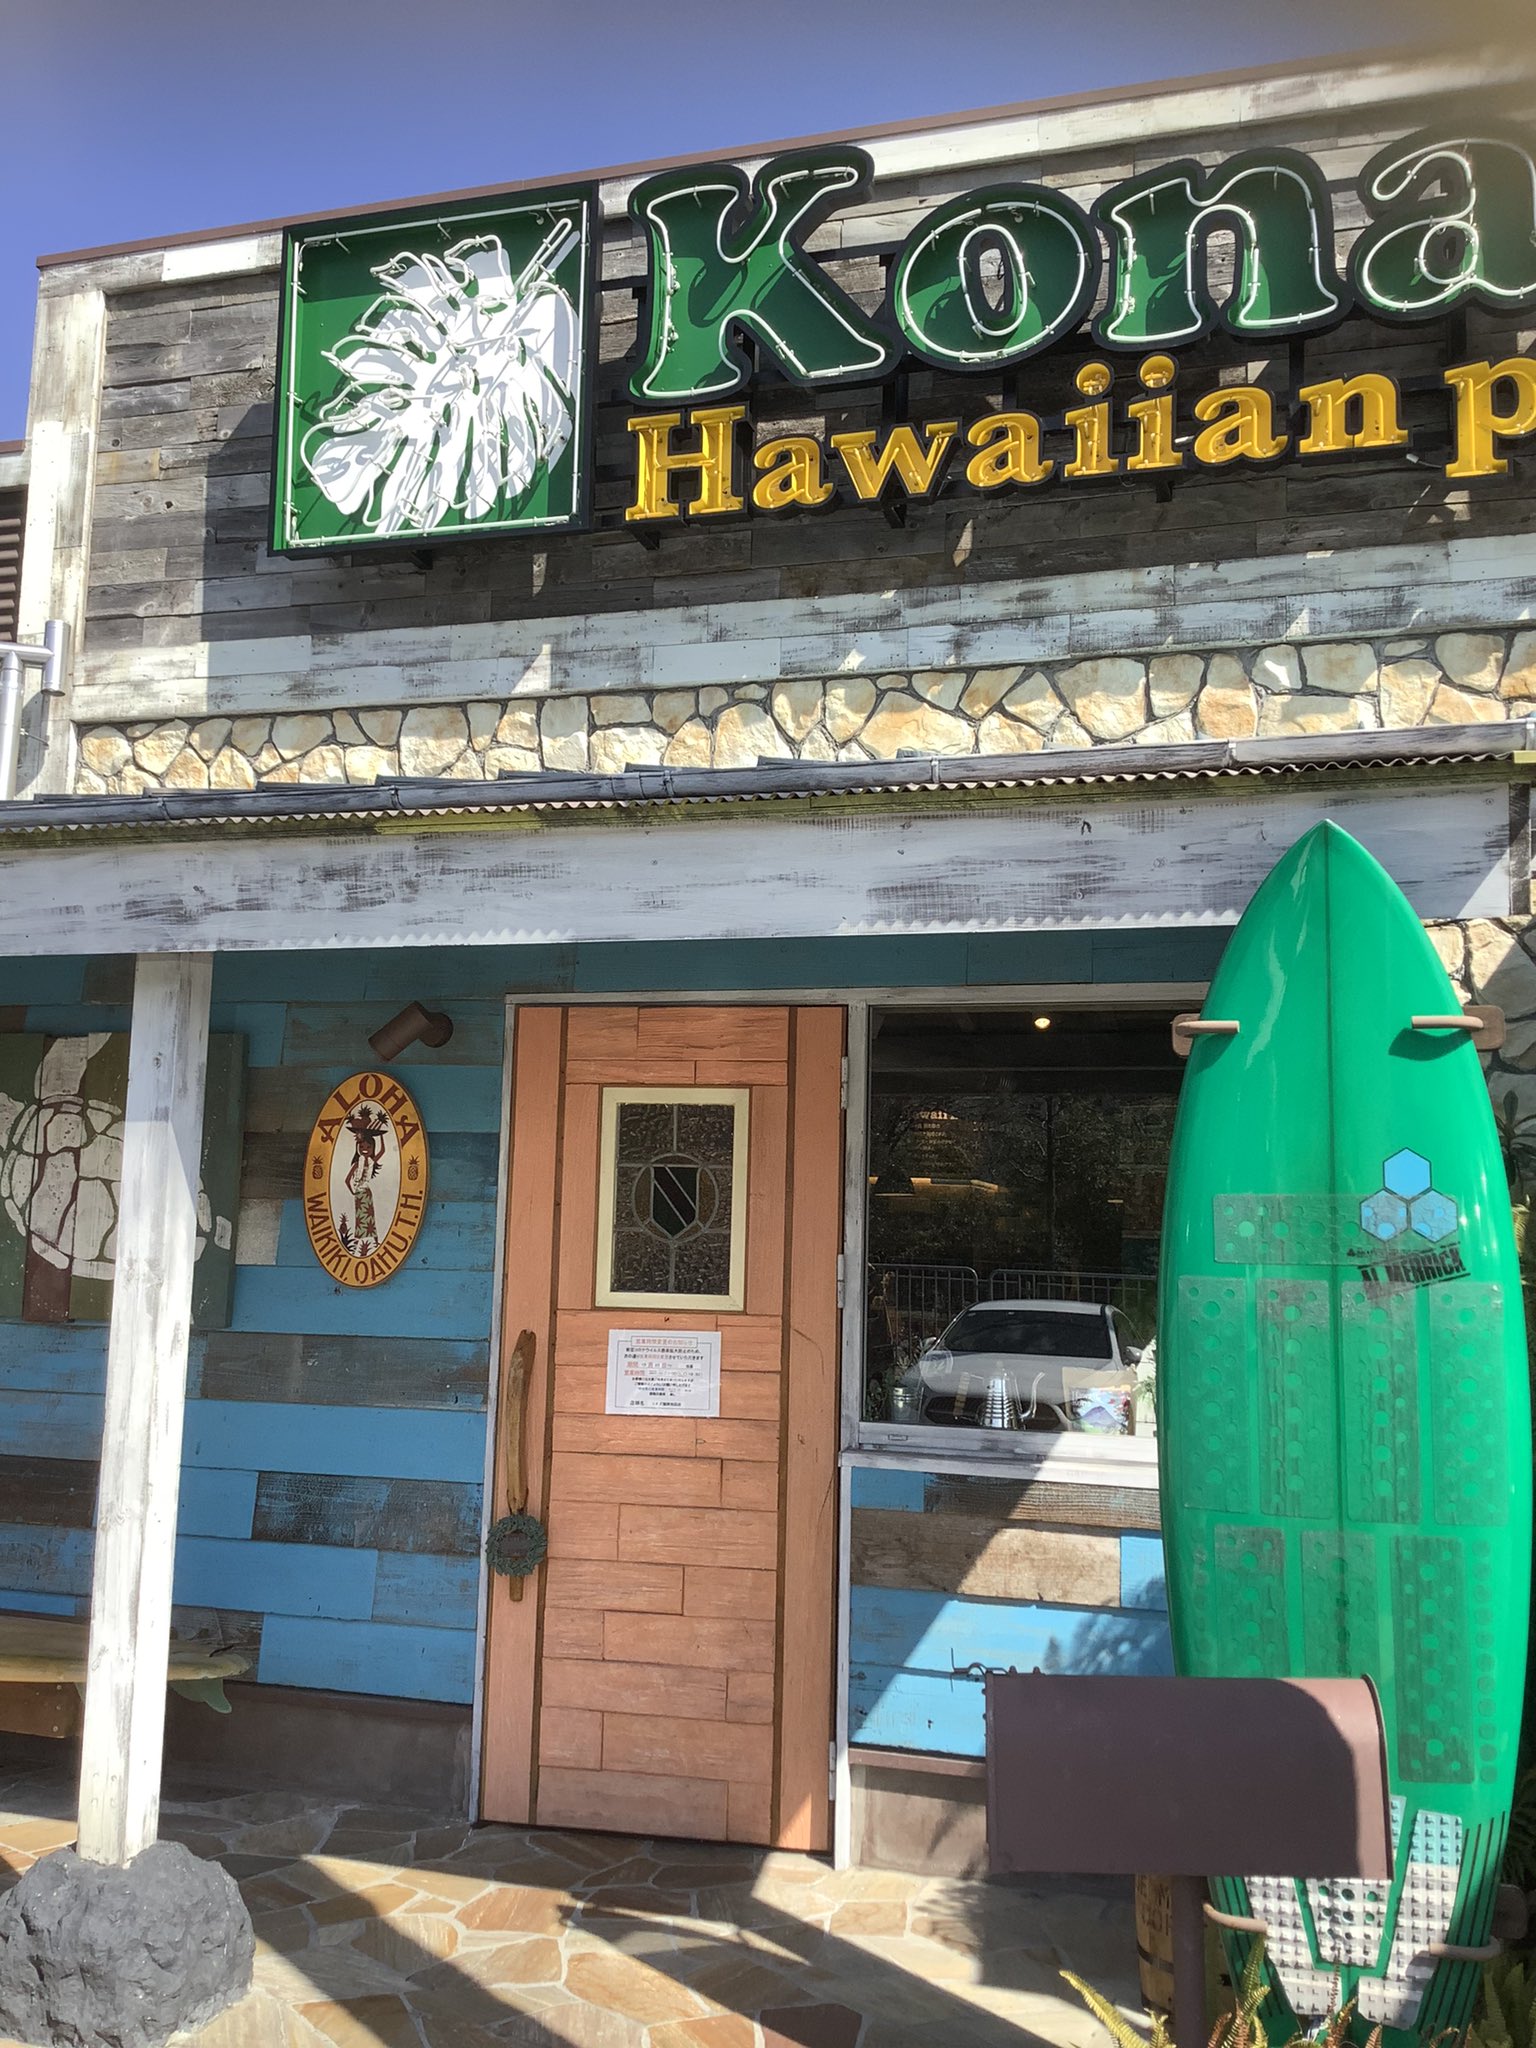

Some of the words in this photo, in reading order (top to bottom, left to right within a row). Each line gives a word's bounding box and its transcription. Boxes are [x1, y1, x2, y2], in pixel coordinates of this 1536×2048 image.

[628, 122, 1536, 402] Kona
[623, 352, 1411, 525] Hawaiian
[316, 1073, 420, 1150] ALOHA
[306, 1190, 349, 1283] WAIKIKI,
